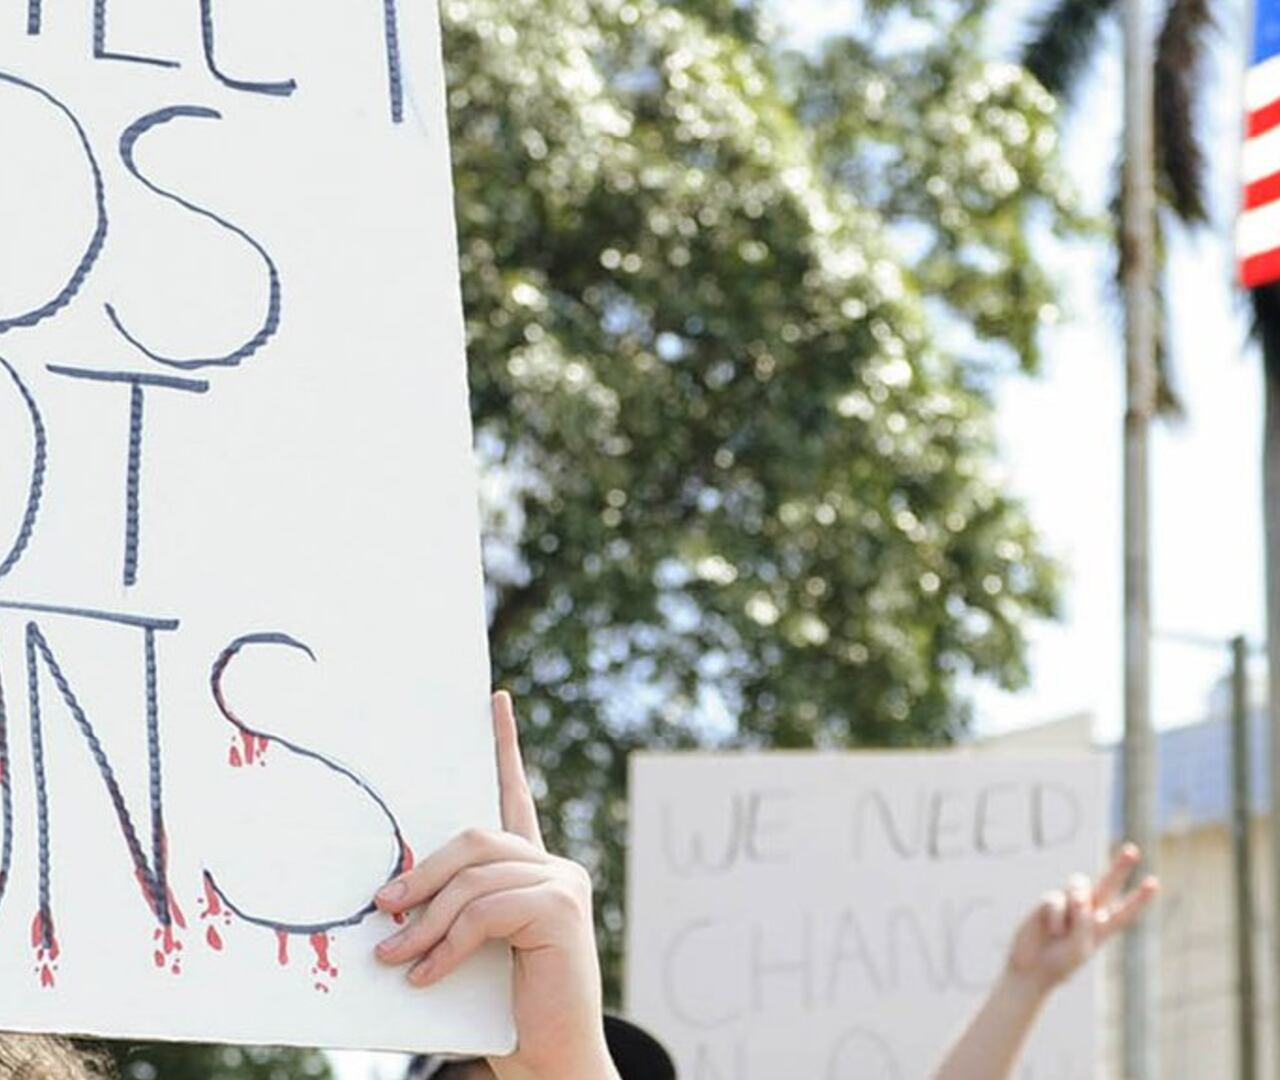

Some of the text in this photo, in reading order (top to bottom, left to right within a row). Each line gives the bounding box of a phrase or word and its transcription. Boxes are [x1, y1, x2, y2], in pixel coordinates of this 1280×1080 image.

[660, 780, 1083, 878] WE NEED
[661, 897, 1010, 1030] CHANG
